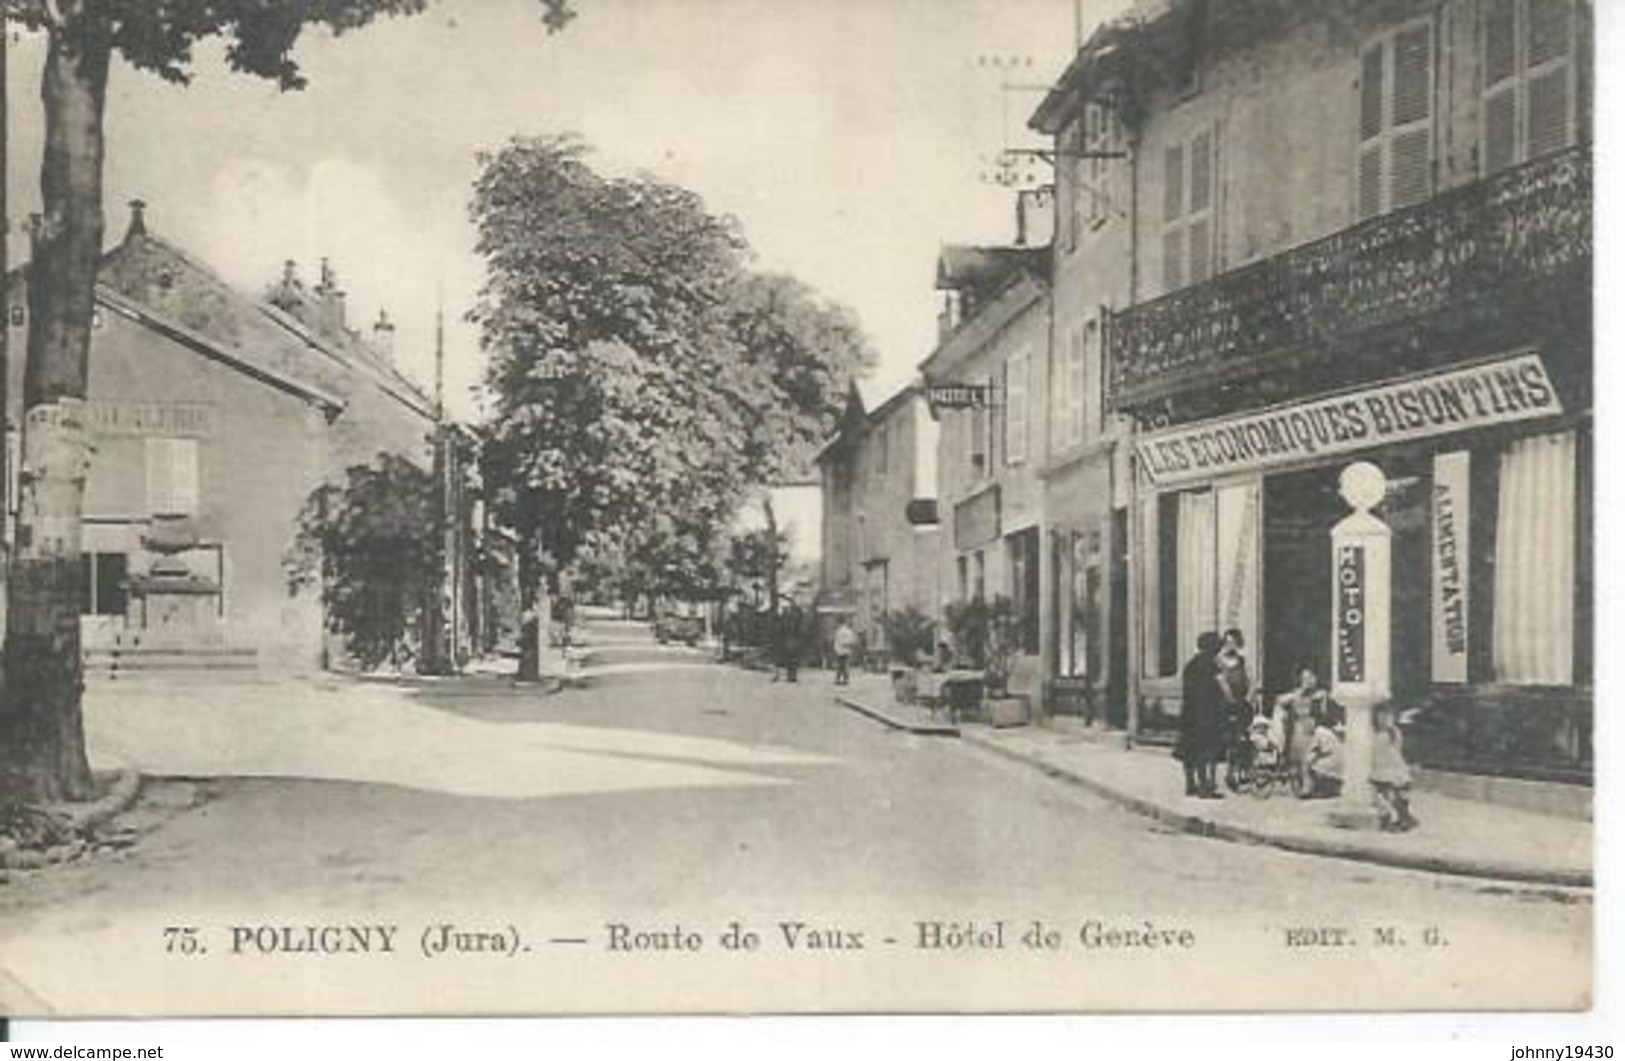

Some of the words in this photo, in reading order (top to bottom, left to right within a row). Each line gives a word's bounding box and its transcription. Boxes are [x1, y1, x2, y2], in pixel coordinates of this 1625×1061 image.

[1143, 442, 1190, 475] LES
[1186, 400, 1367, 467] ECONOMIQUES
[1366, 362, 1551, 434] BISONTINS
[1435, 484, 1466, 657] ALIMENTATION
